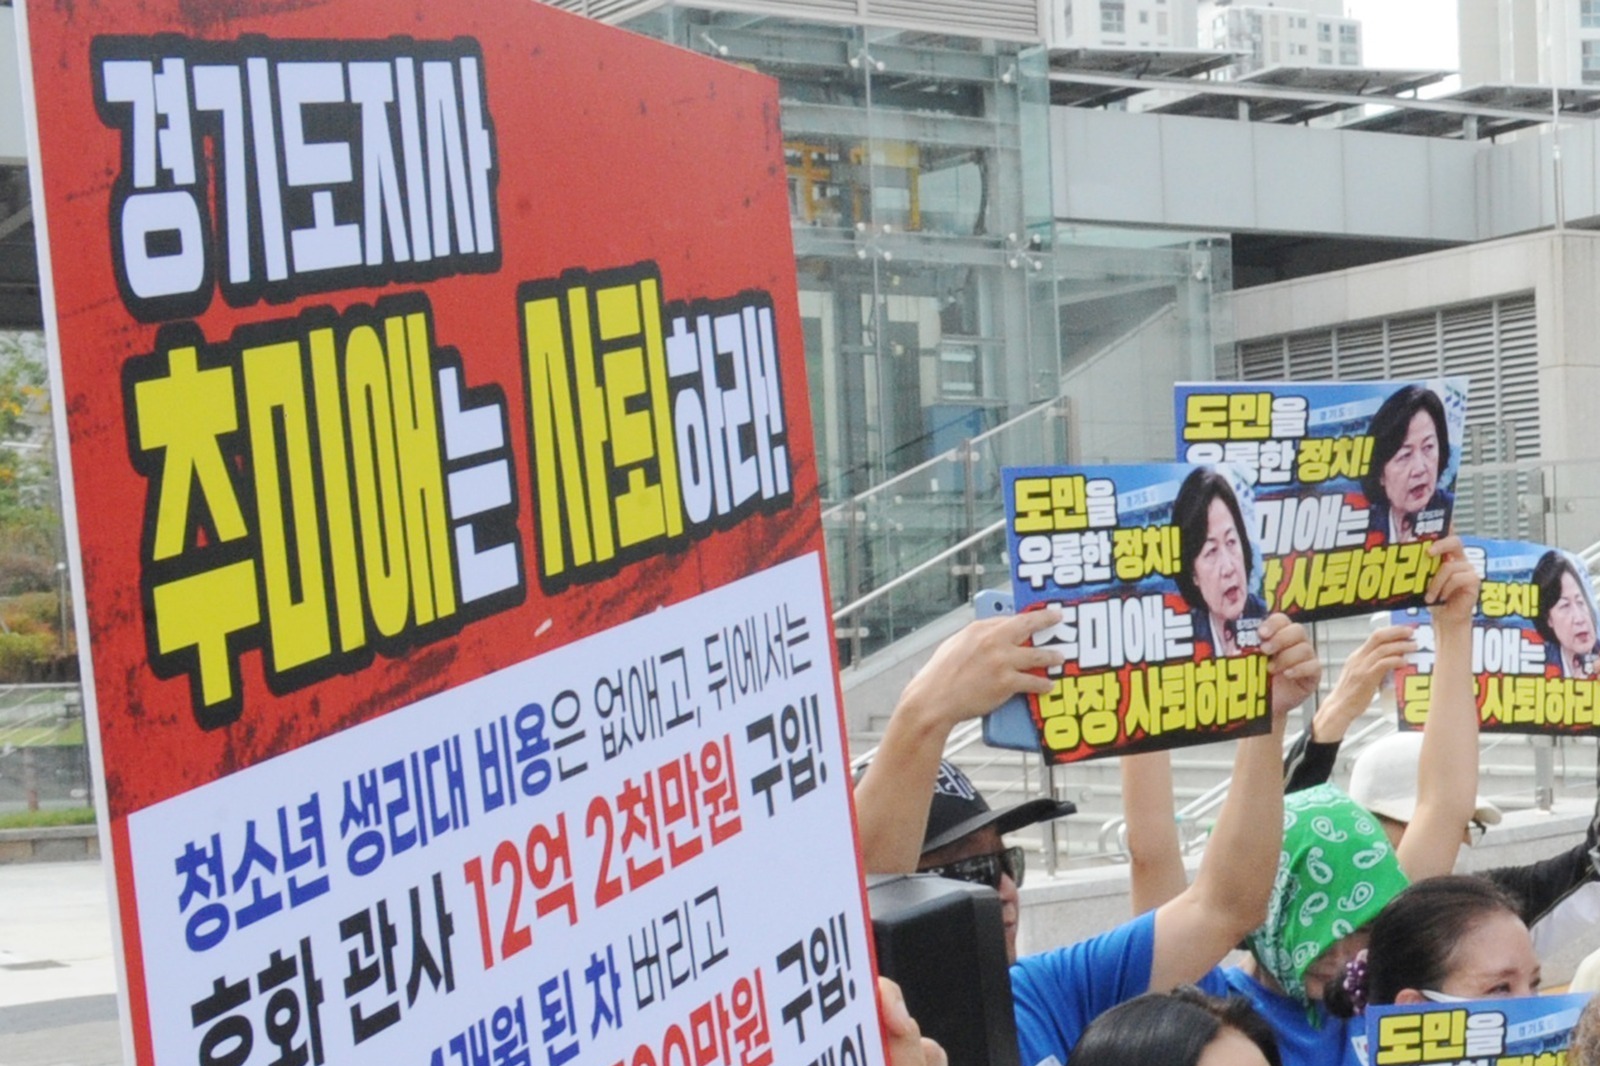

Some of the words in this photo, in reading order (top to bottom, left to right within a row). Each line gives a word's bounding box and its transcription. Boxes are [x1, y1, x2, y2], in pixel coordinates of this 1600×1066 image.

[102, 56, 496, 300] 경기도지사
[1183, 391, 1308, 441] 도민을
[132, 311, 520, 708] 추미애는
[523, 277, 791, 578] 사퇴하라!
[1297, 435, 1376, 484] 정치!
[1013, 474, 1118, 533] 도민을
[1257, 493, 1371, 556] 미애는
[1017, 529, 1112, 589] 우롱한
[1112, 525, 1182, 581] 정치!
[1032, 594, 1194, 676] 추미애는
[1480, 580, 1540, 618] 정치!
[1037, 671, 1121, 751] 당장
[1125, 655, 1268, 736] 사퇴하라!
[174, 792, 330, 953] 청소년
[340, 740, 470, 878] 생리대
[477, 688, 589, 815] 비용은
[594, 650, 704, 764] 없애고,
[704, 601, 813, 701] 뒤에서는
[339, 871, 456, 1048] 관사
[463, 810, 579, 971] 12억
[584, 732, 744, 906] 2천만원
[745, 693, 830, 819] 구입!
[584, 944, 625, 1039] 차
[627, 883, 731, 1012] 버리고
[775, 912, 860, 1046] 구입!
[1375, 1008, 1507, 1066] 도민을
